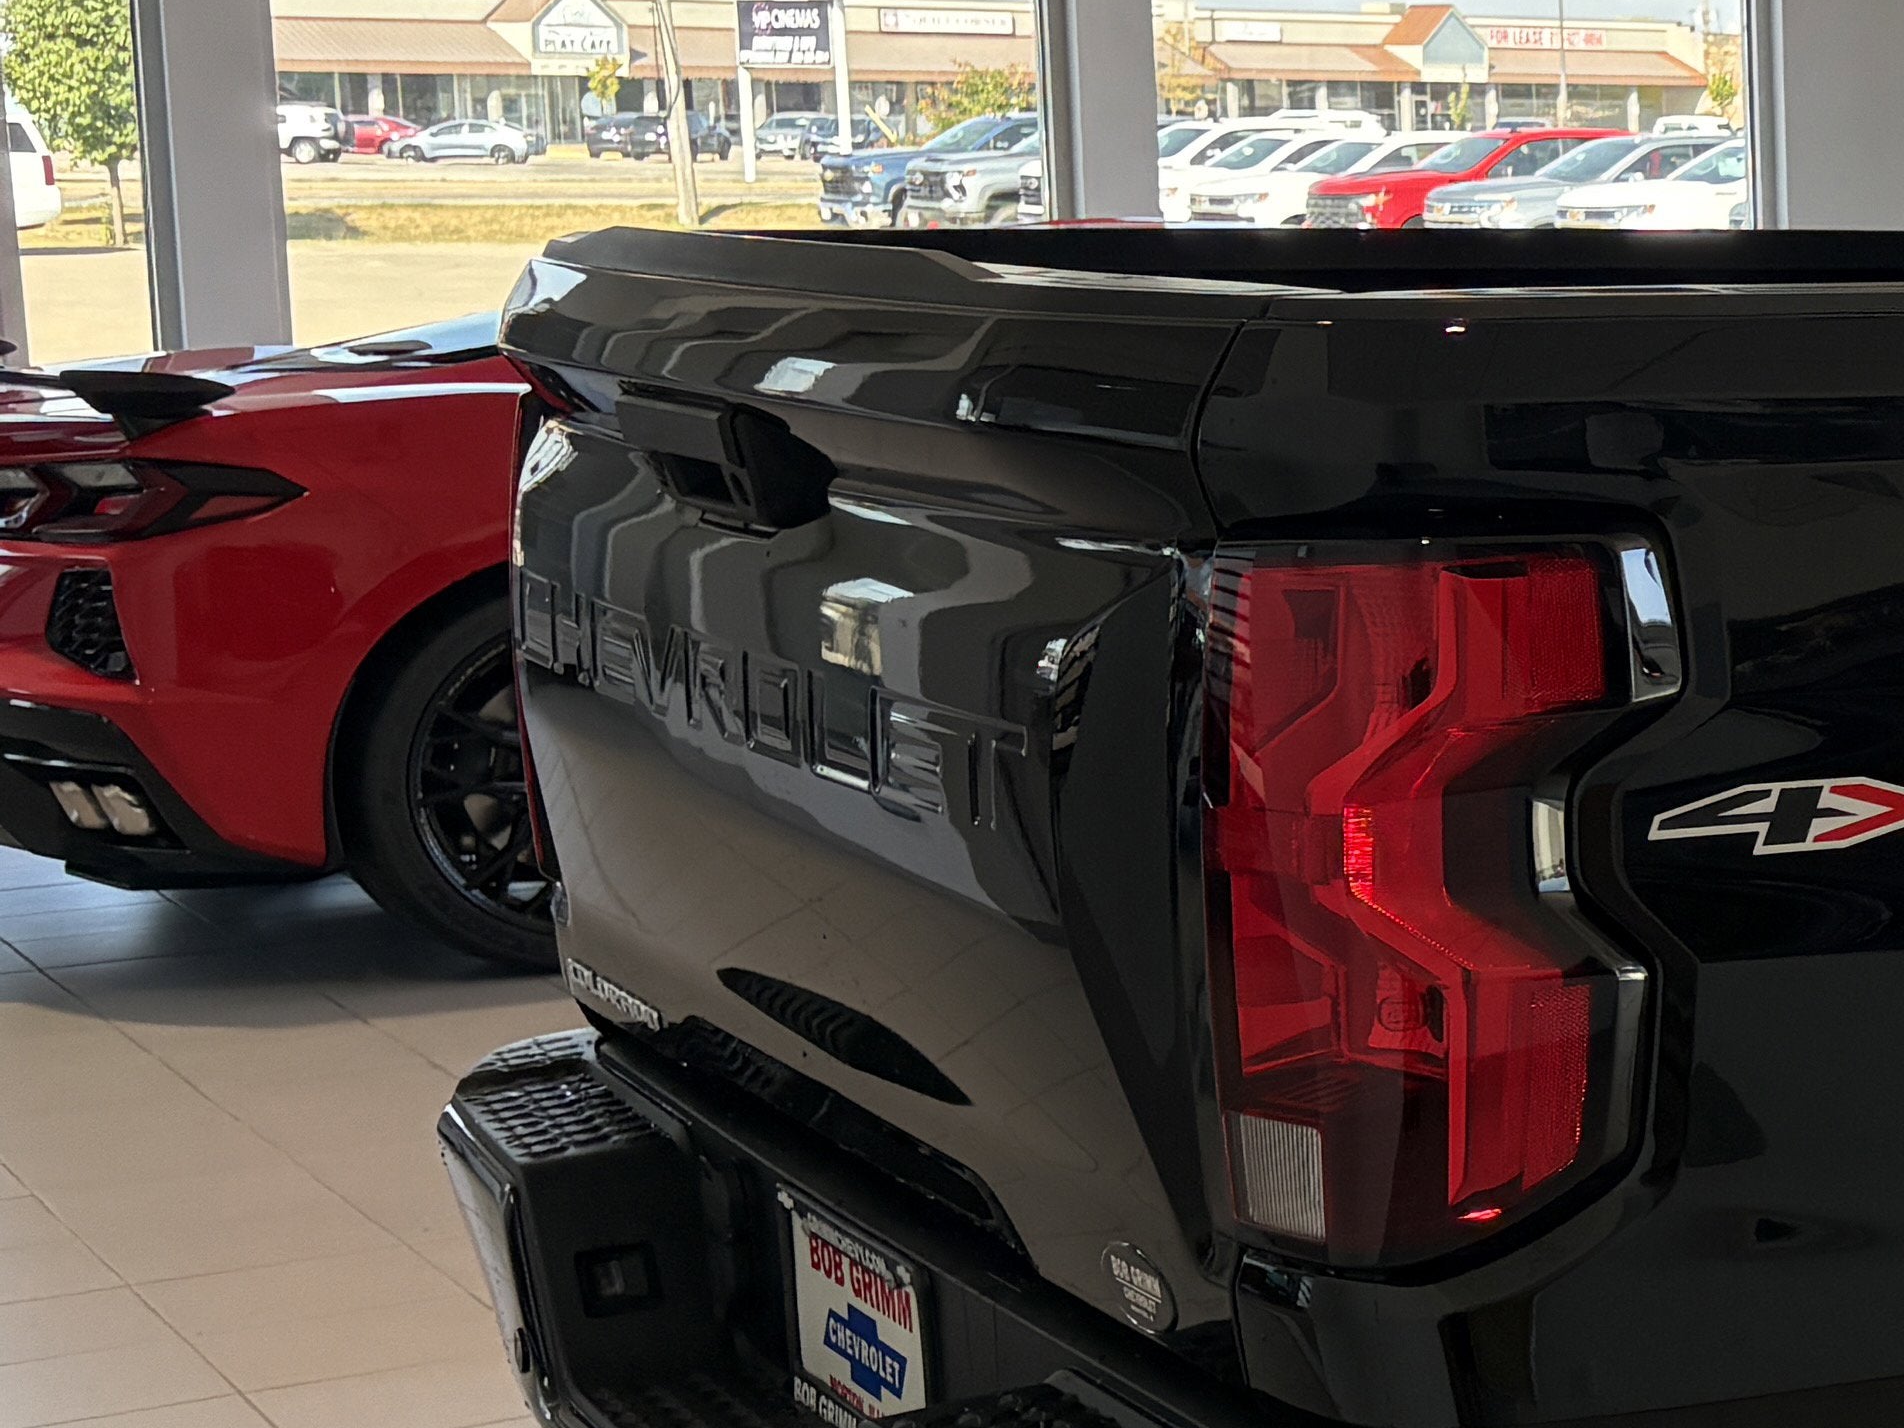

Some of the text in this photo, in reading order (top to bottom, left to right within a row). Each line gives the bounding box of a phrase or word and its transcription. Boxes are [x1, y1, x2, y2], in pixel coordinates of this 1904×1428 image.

[771, 8, 821, 29] CINEMAS
[1490, 28, 1509, 45] FOR
[1514, 29, 1543, 46] LEASE
[809, 1231, 914, 1334] BOB GRIMM
[828, 1316, 901, 1389] CHEVROLET
[793, 1375, 817, 1413] BOB
